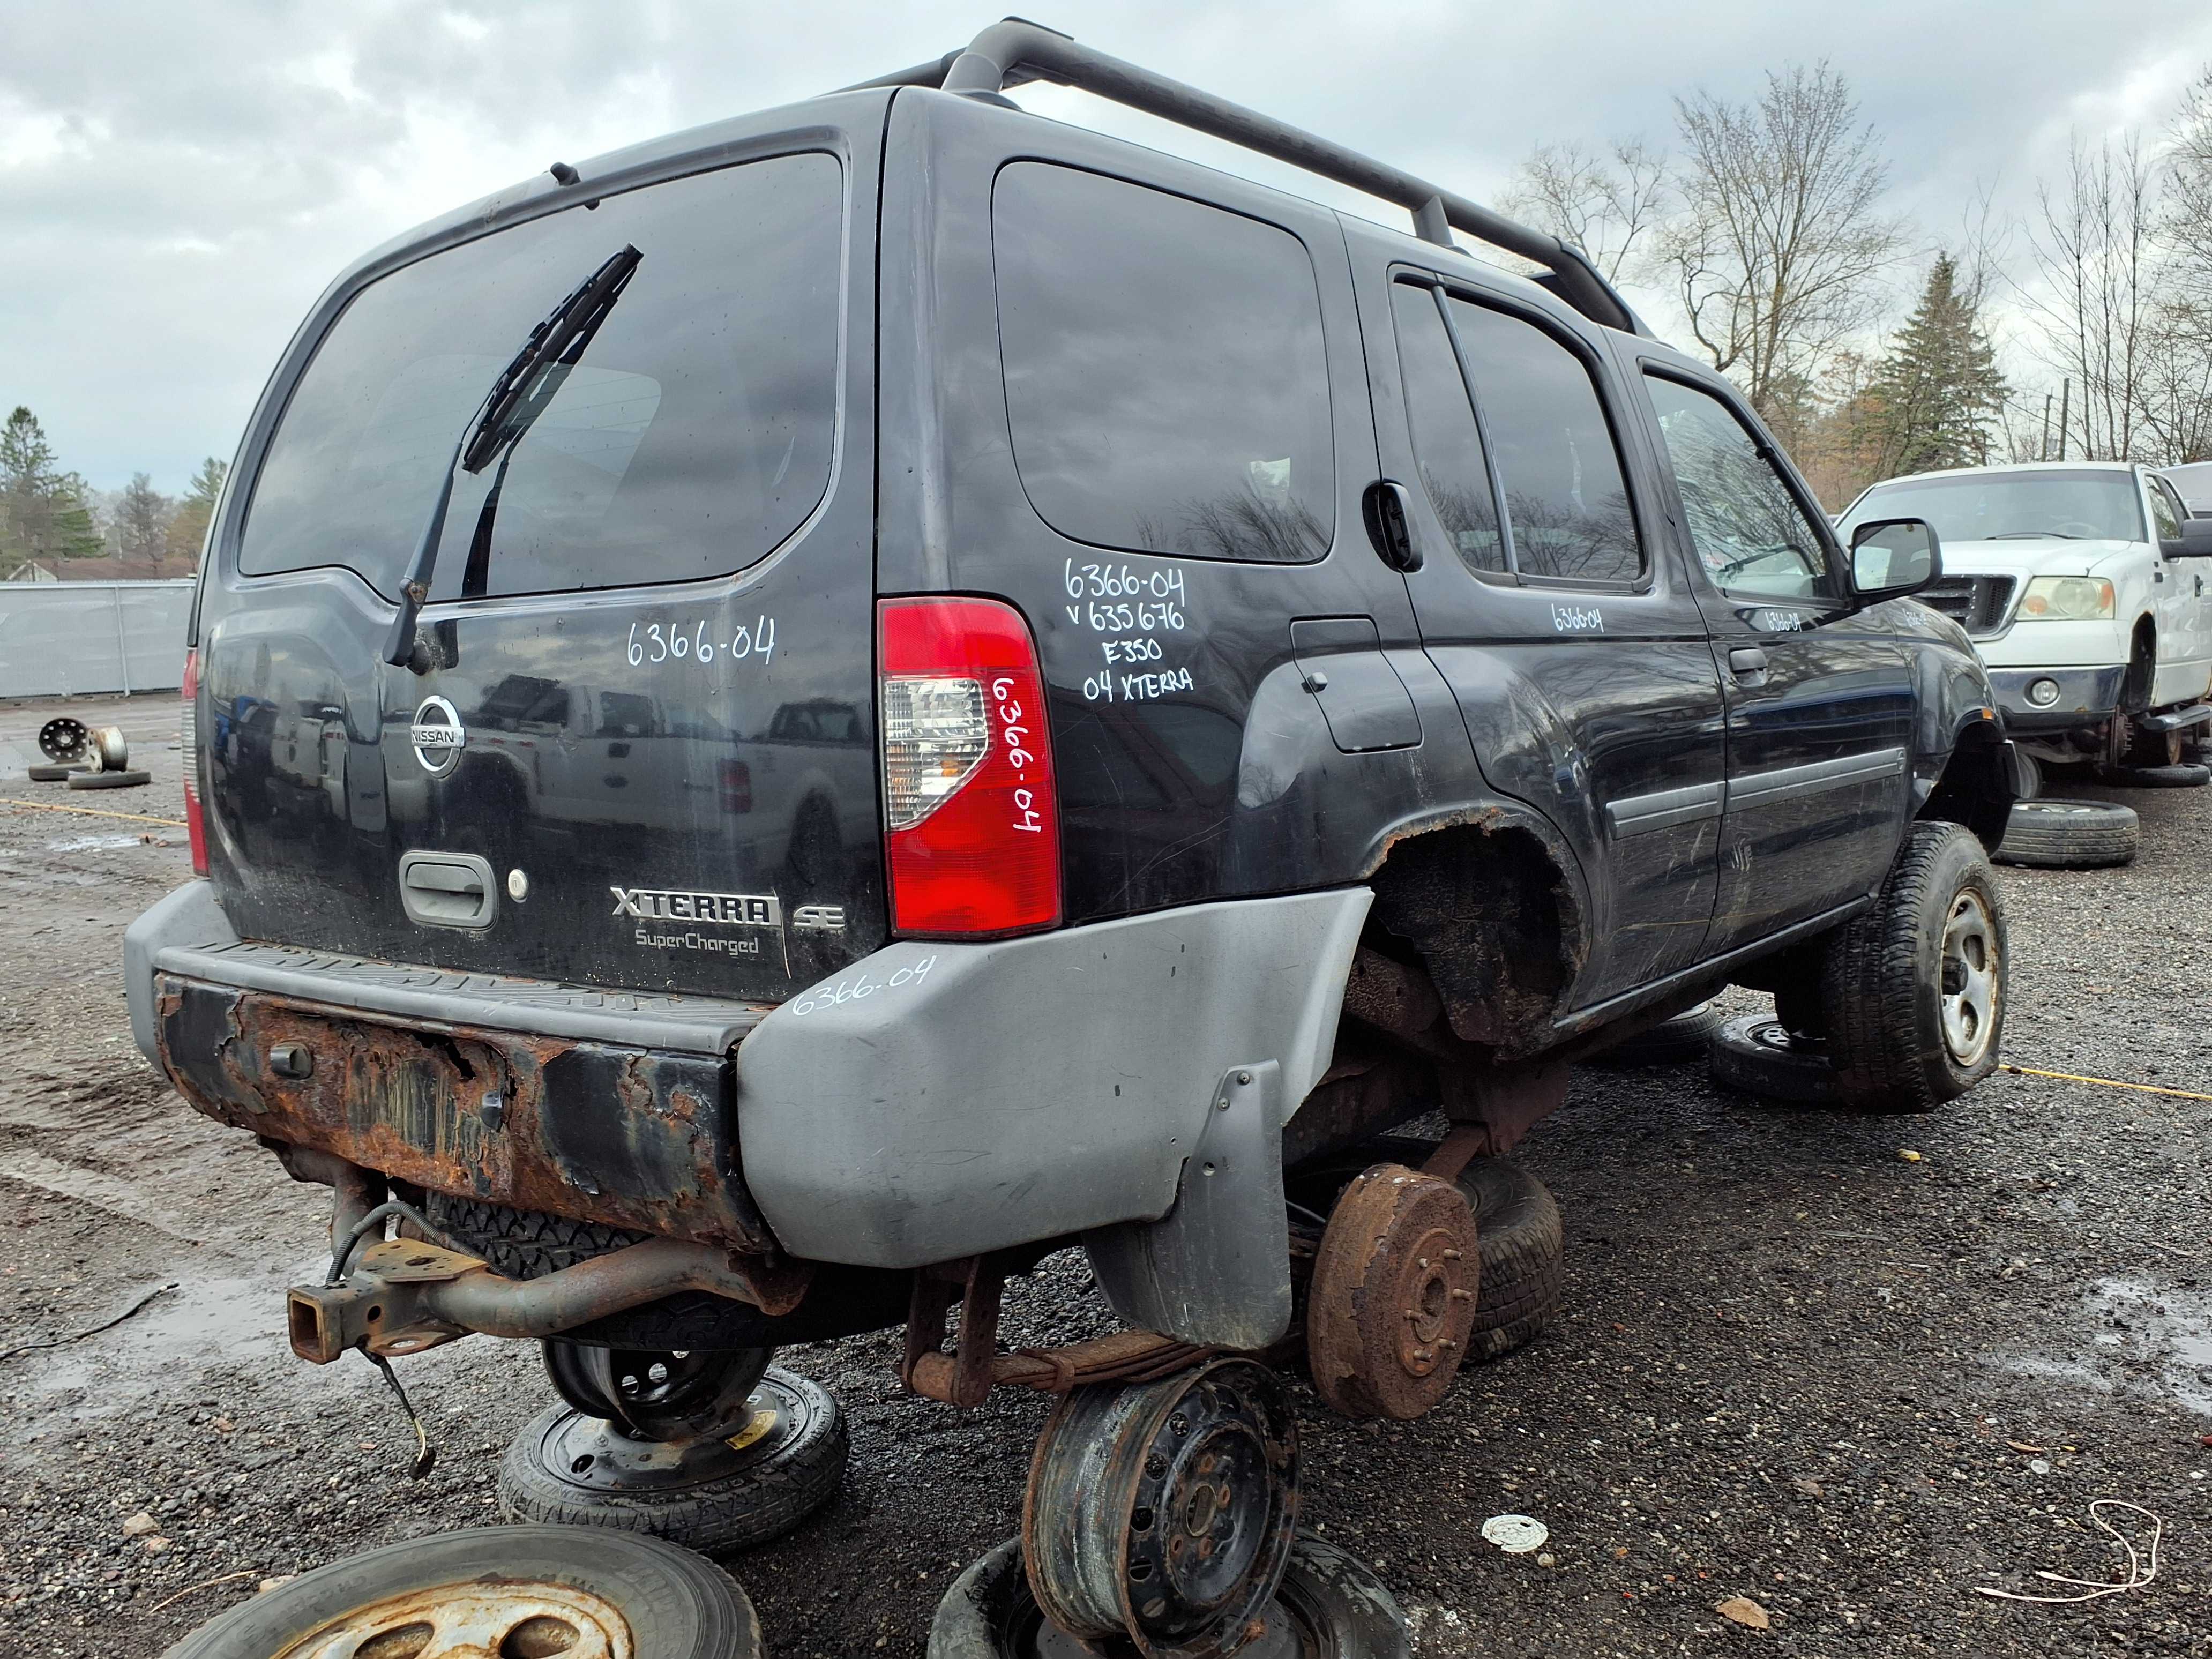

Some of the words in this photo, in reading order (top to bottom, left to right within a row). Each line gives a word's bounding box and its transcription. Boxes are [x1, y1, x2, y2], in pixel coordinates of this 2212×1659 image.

[1065, 557, 1185, 607] 6366-04
[1089, 601, 1185, 631] 635676
[1551, 603, 1605, 633] 6366-04
[627, 615, 775, 666] 6366-04
[1102, 638, 1162, 664] E350
[1083, 669, 1113, 703] 04
[1121, 667, 1194, 701] XTERRA
[412, 730, 454, 743] NISSAN
[992, 677, 1042, 833] 6366-04
[610, 886, 781, 926] XTERRA
[793, 906, 846, 930] SE
[635, 929, 759, 956] SuperCharged
[792, 955, 937, 1017] 6366-04
